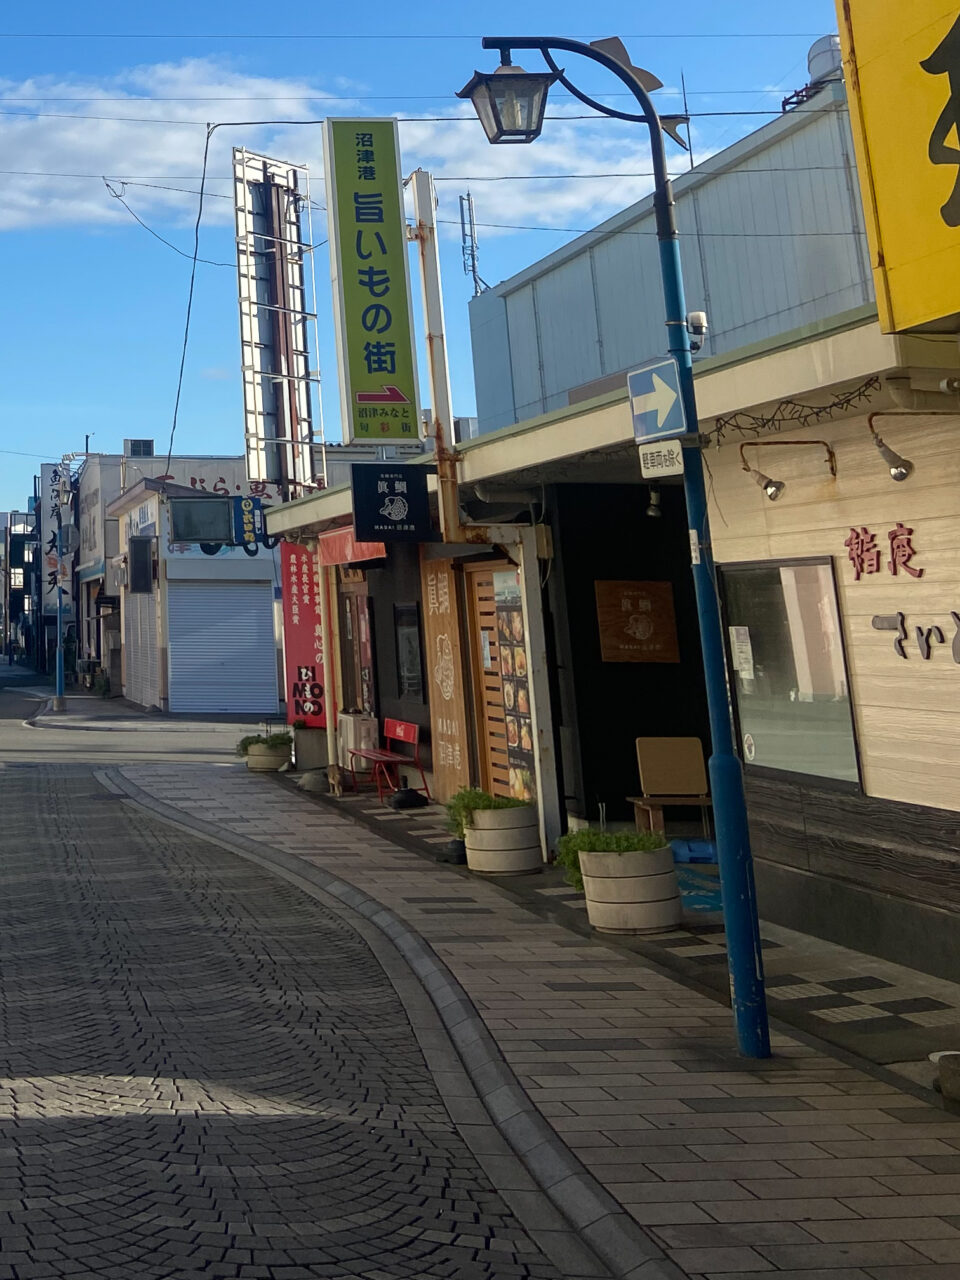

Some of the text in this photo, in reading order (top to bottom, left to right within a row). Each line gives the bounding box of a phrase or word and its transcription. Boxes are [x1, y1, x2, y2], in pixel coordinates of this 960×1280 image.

[353, 133, 396, 374] 沼津港 旨いもの街
